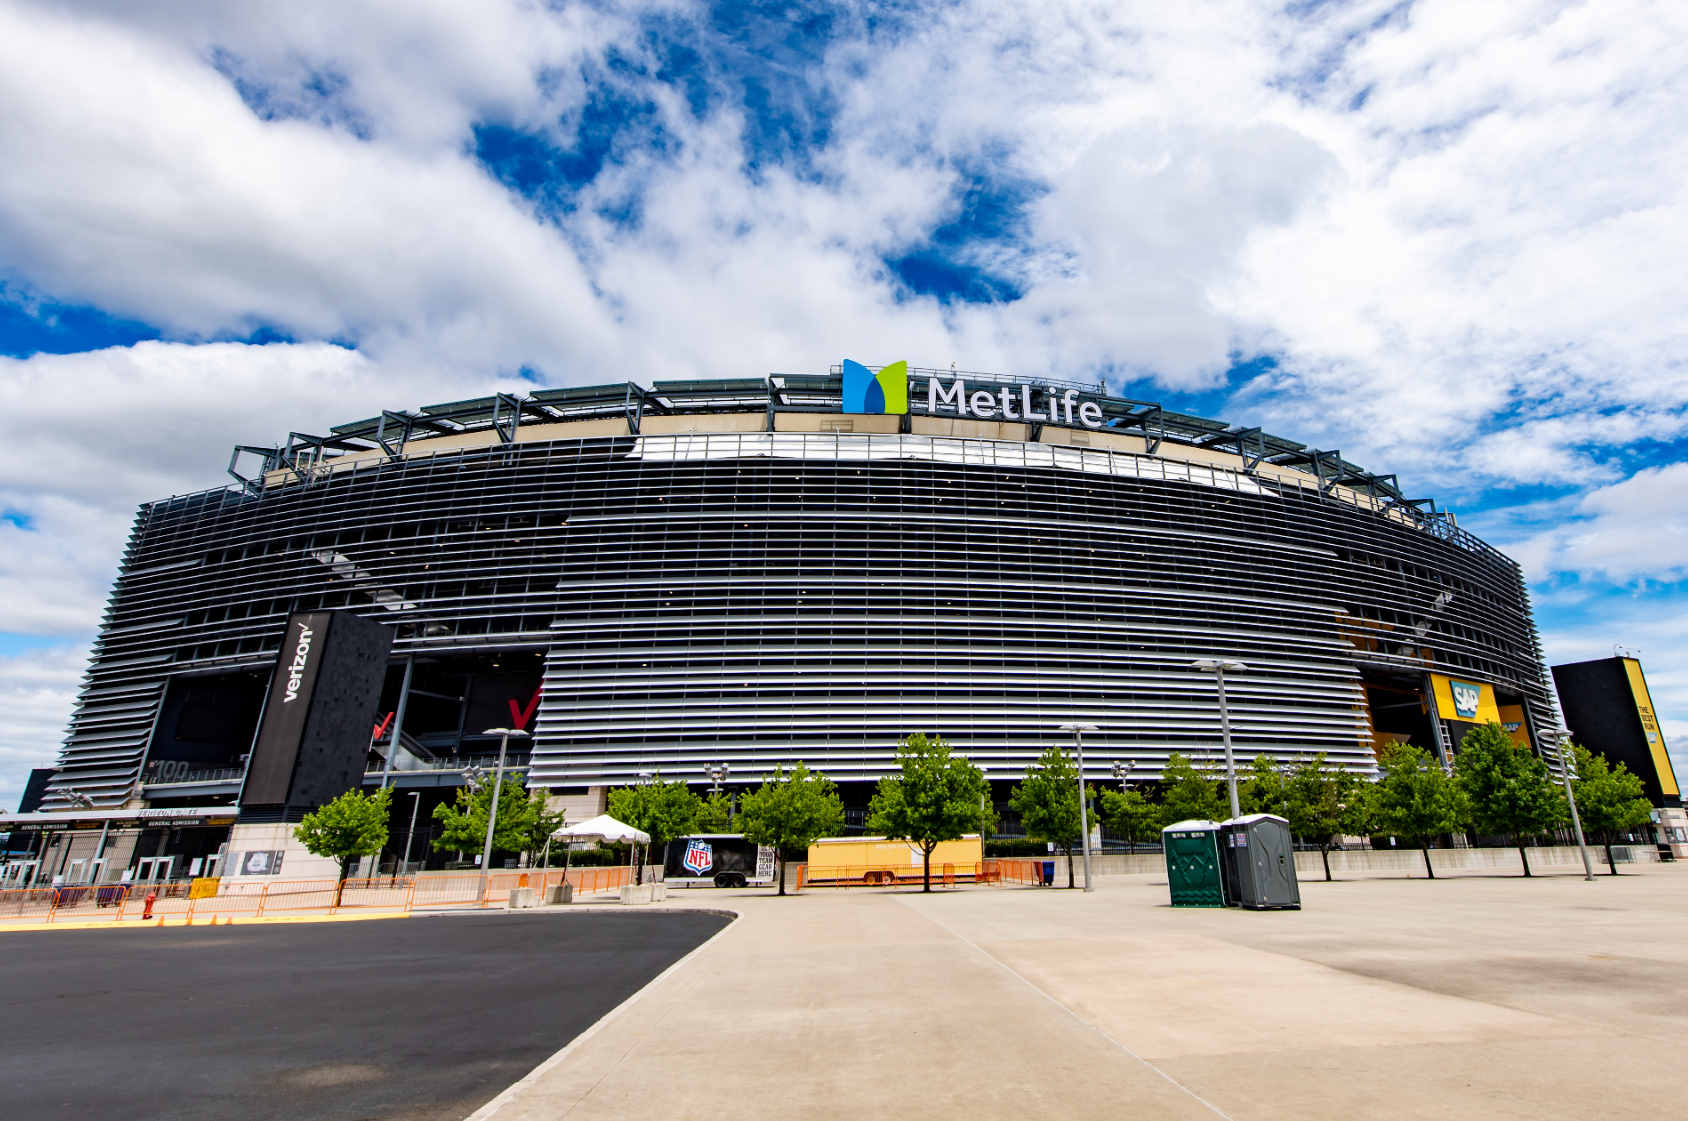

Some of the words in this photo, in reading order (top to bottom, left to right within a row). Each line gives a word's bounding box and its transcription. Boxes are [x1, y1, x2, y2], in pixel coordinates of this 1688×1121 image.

[928, 377, 1103, 428] MetLife
[283, 629, 314, 704] verizon
[1454, 686, 1479, 712] SAP
[1638, 705, 1649, 714] THE
[1641, 714, 1654, 722] BEST
[155, 760, 190, 780] 100
[136, 809, 172, 817] VERIZON
[174, 808, 199, 816] GATE
[689, 849, 711, 868] NFL
